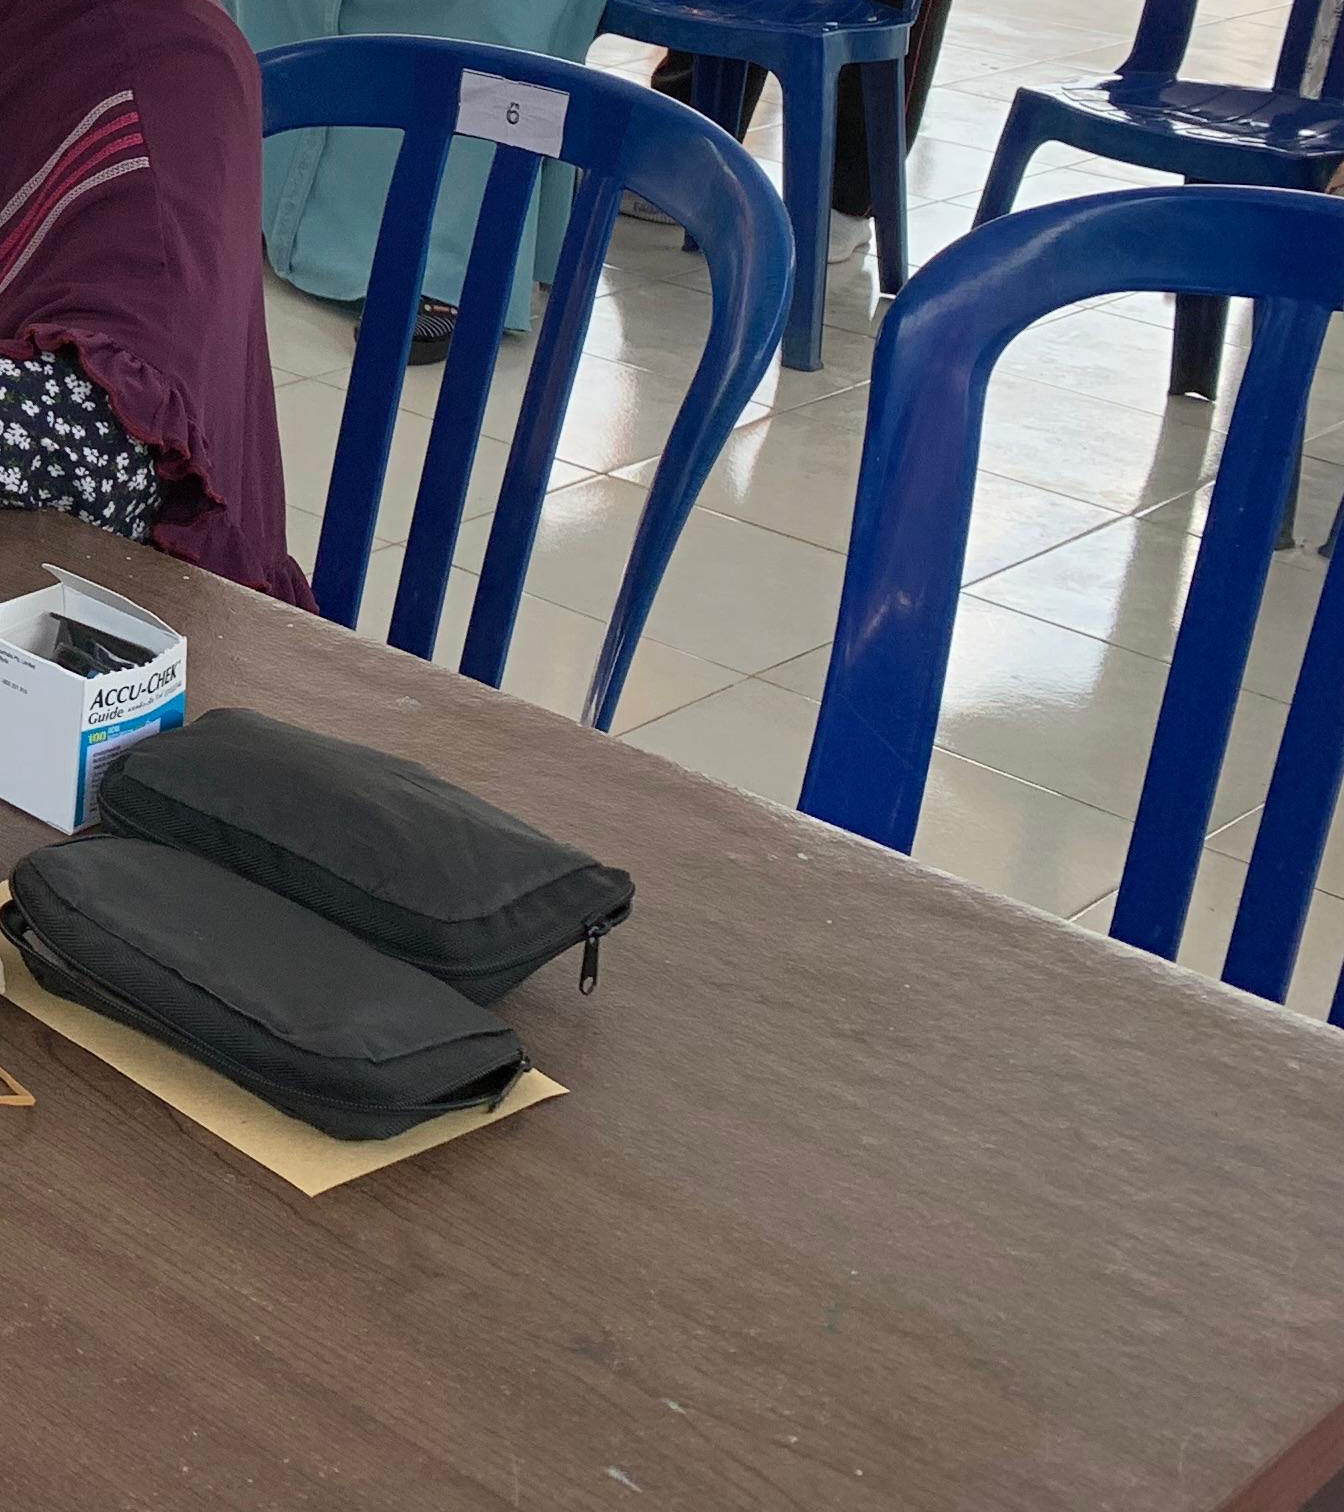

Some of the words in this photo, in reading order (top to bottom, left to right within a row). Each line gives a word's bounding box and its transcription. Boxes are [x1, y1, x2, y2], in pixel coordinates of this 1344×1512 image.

[506, 102, 520, 125] 6
[89, 664, 177, 711] ACCU-CHEK
[88, 706, 125, 725] Guide
